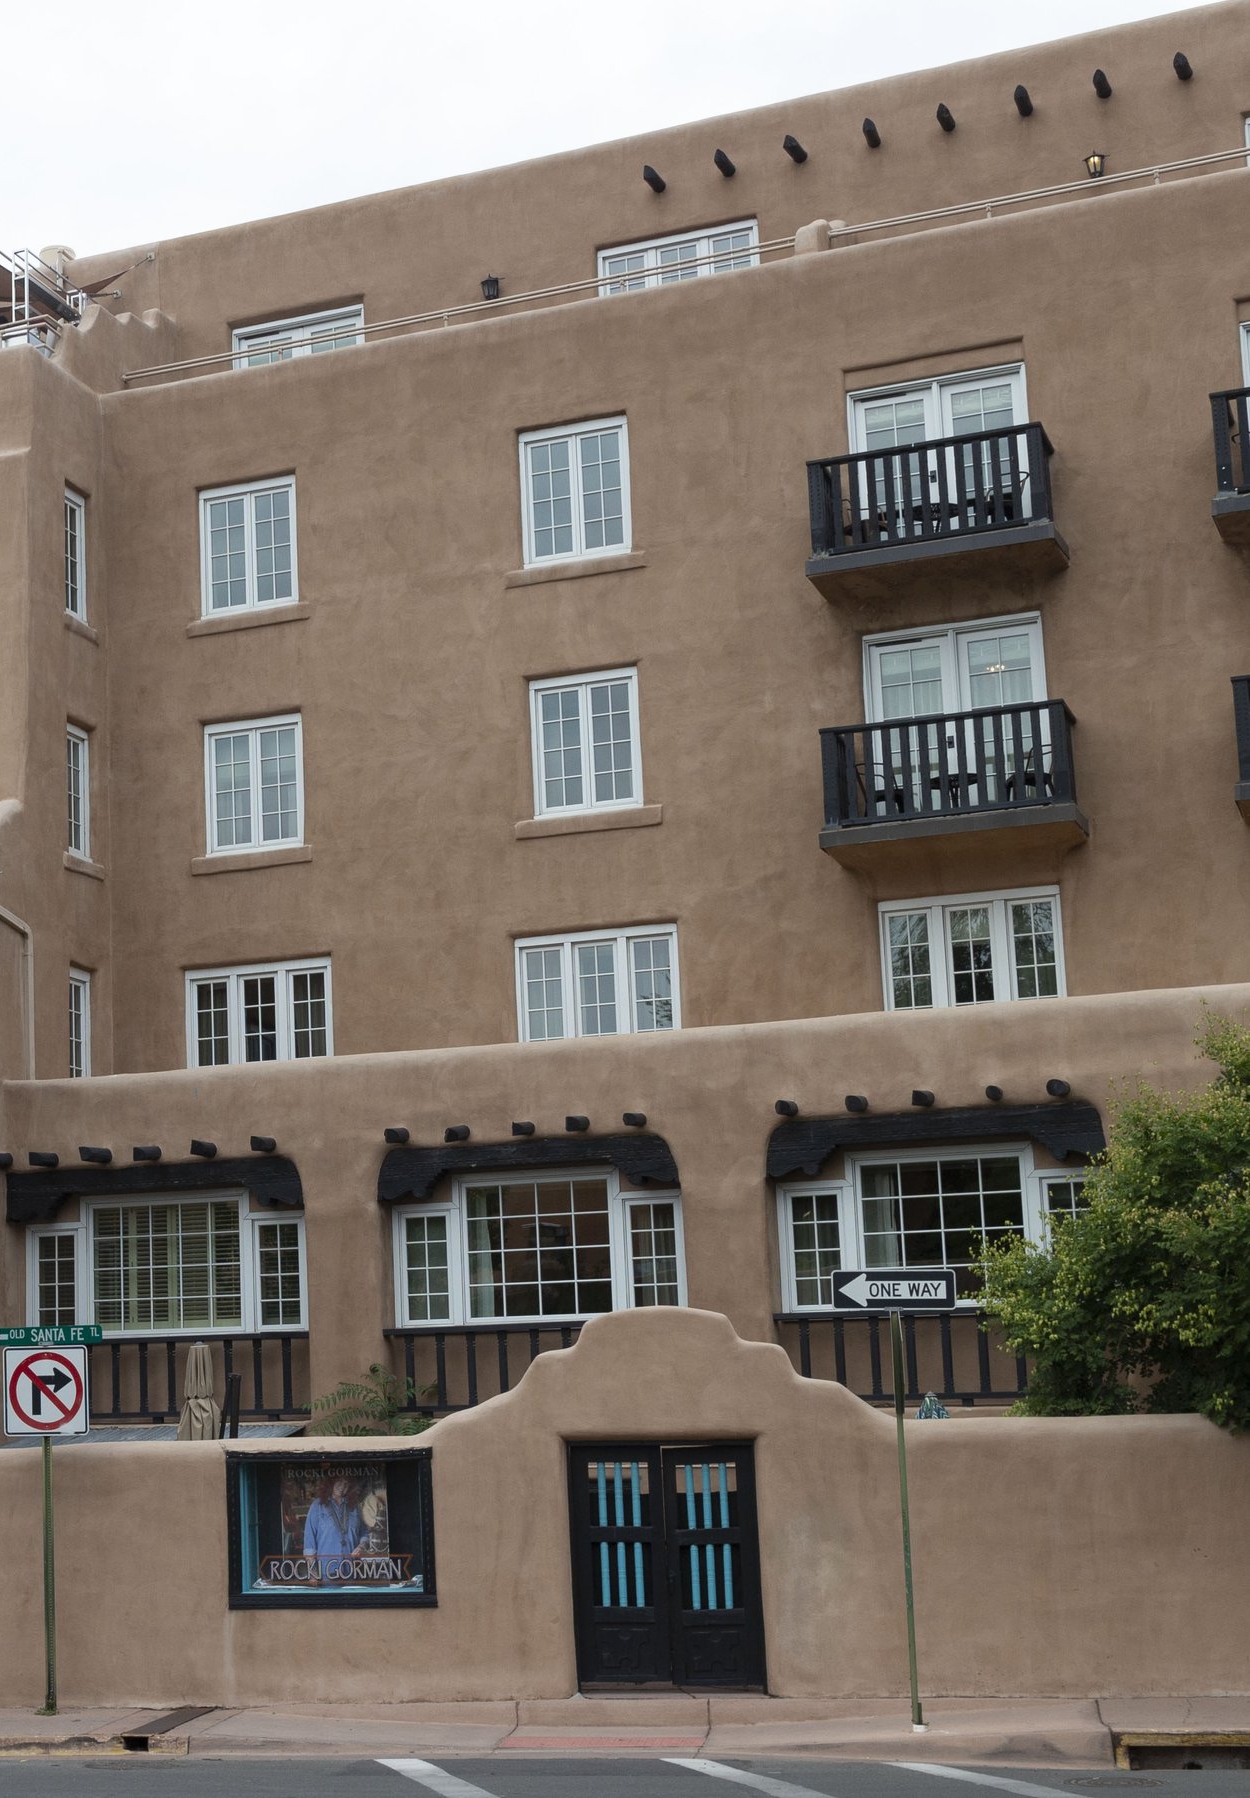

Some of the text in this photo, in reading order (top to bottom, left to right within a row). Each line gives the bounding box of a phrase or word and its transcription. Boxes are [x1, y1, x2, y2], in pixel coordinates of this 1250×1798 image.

[869, 1283, 942, 1298] ONE WAY
[9, 1327, 100, 1342] OLD SANTA FE TL
[287, 1467, 379, 1479] ROCKI GORMAN
[270, 1558, 402, 1580] ROCKI GORMAN
